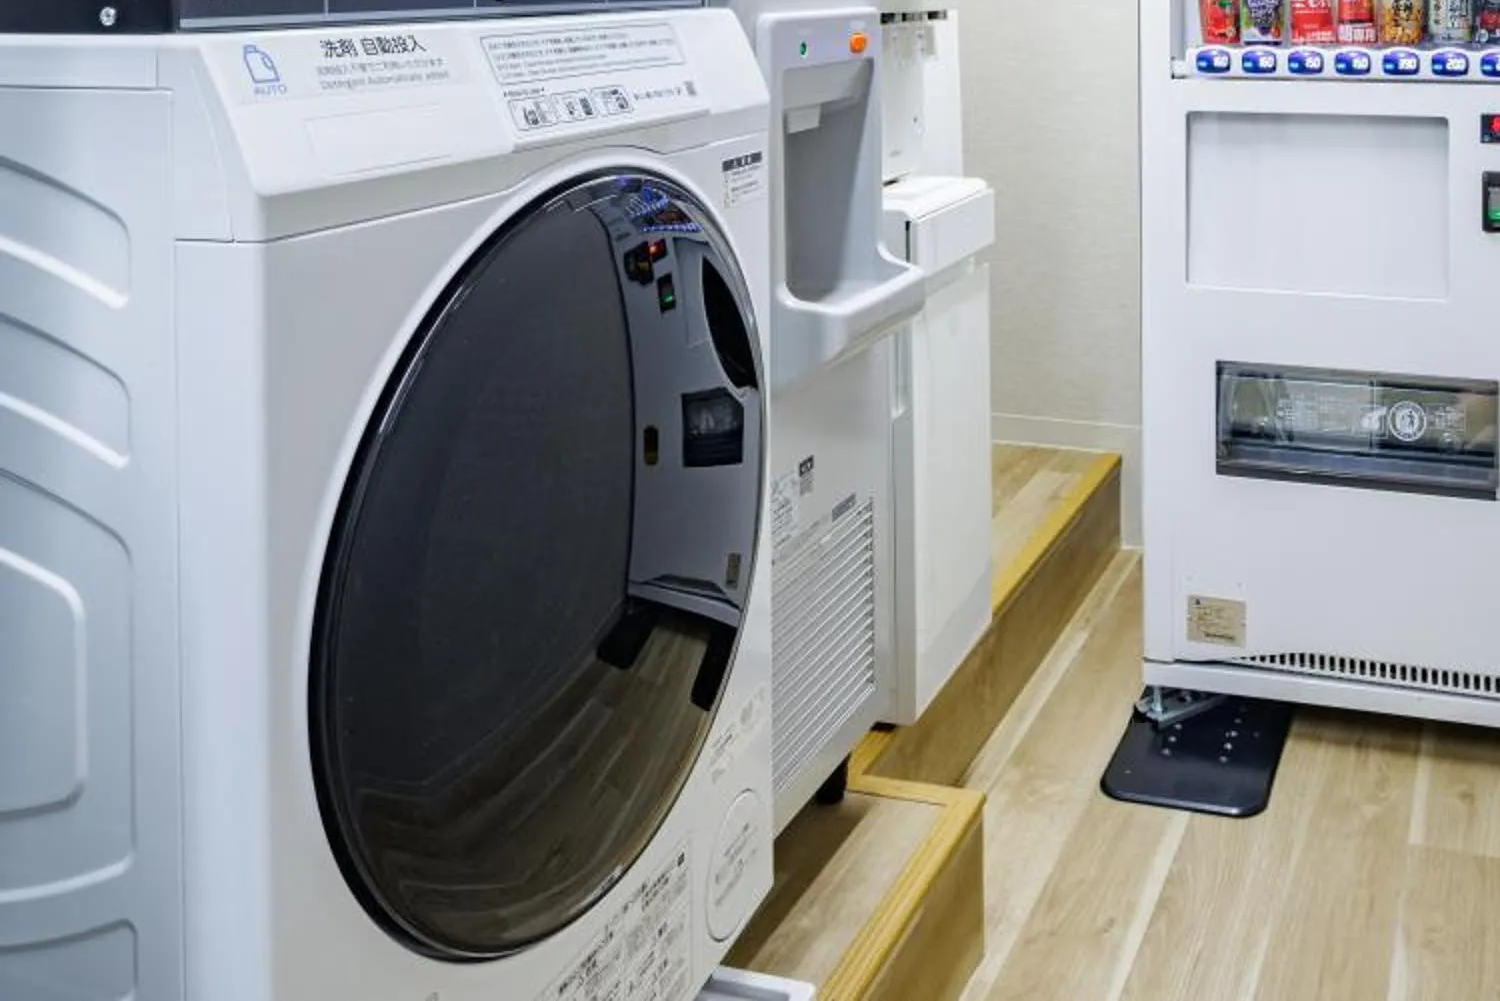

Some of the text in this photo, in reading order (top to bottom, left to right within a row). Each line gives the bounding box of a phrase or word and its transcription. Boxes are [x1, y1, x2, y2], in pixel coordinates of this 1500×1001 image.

[320, 34, 427, 58] 洗剤 自動投入
[253, 84, 288, 96] AUTO
